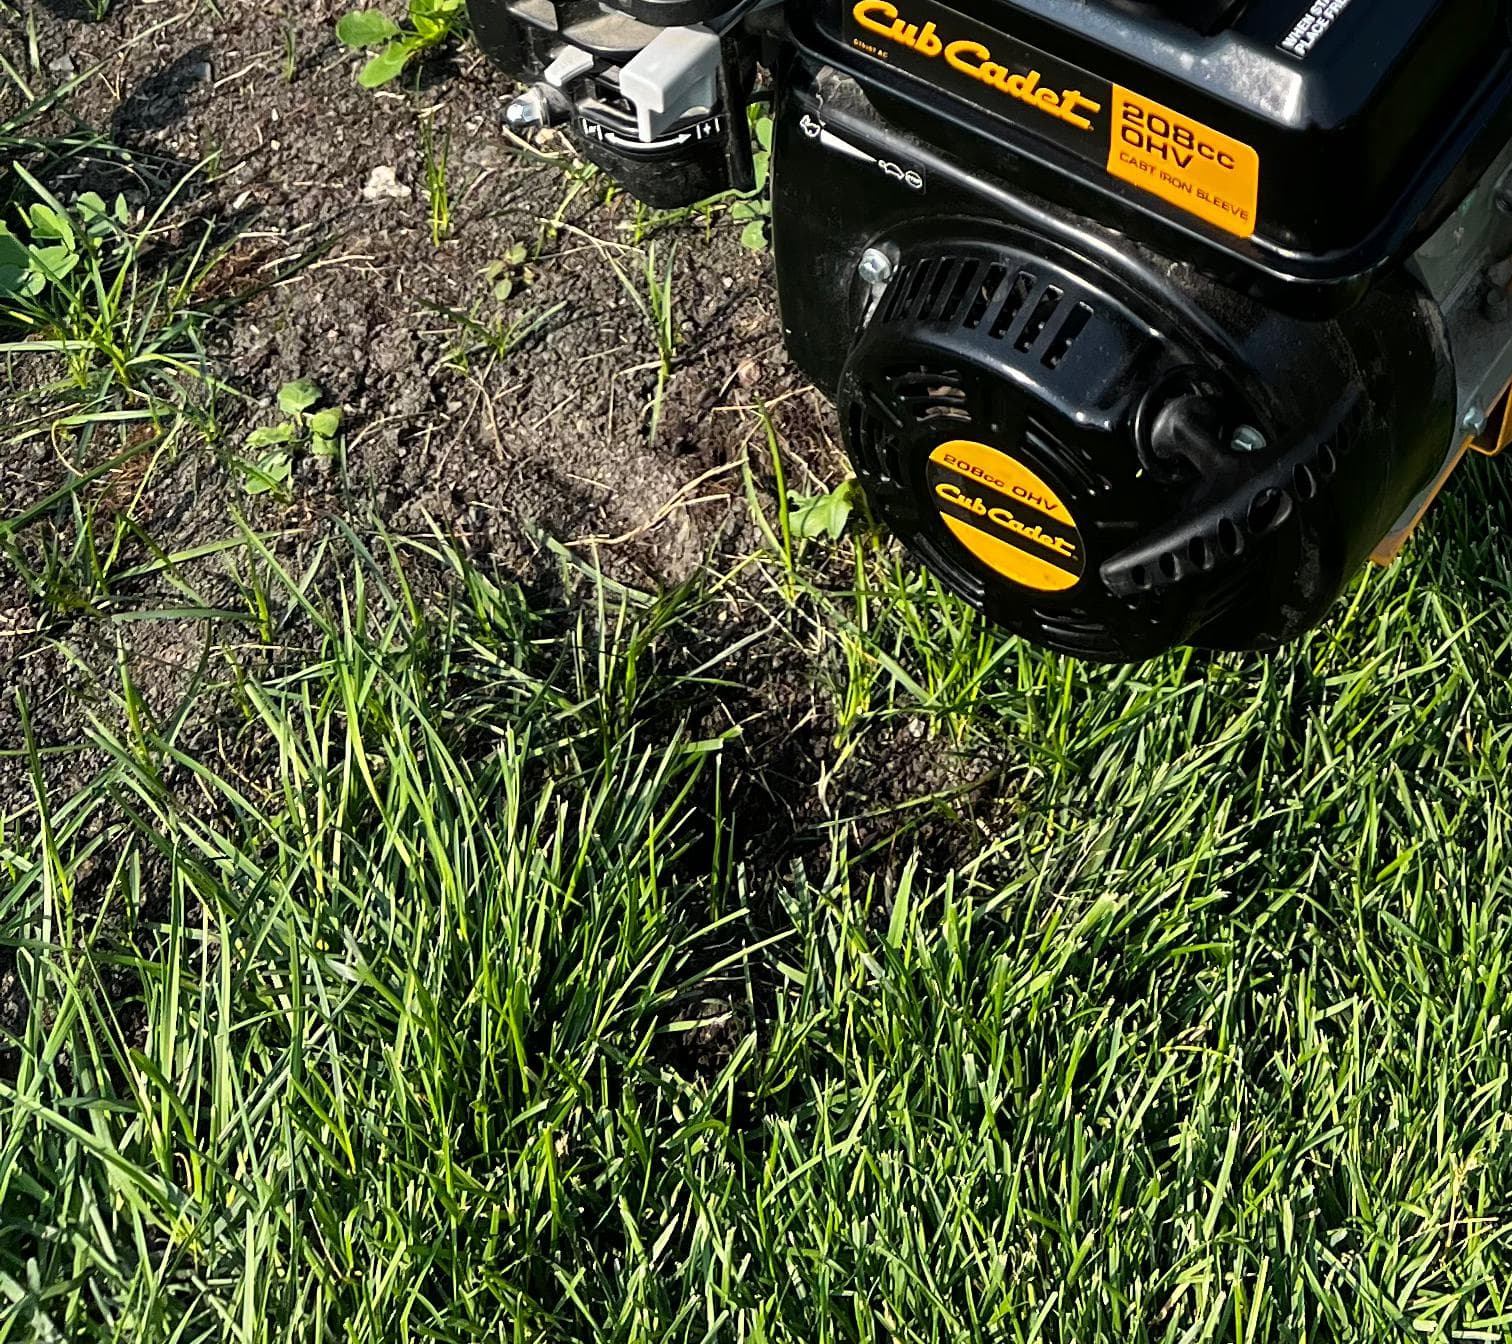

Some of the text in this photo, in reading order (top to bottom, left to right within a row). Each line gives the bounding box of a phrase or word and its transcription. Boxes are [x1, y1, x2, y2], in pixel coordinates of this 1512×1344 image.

[1281, 13, 1316, 48] WHEN
[1294, 16, 1330, 56] PLACE
[943, 40, 1101, 131] Cadet
[1121, 124, 1194, 169] OHV
[1122, 101, 1236, 170] 208cc
[1119, 152, 1249, 221] CAST IRON SLEEVE
[943, 453, 1058, 512] 208cc OHV
[935, 483, 1076, 557] Cub Cadet
